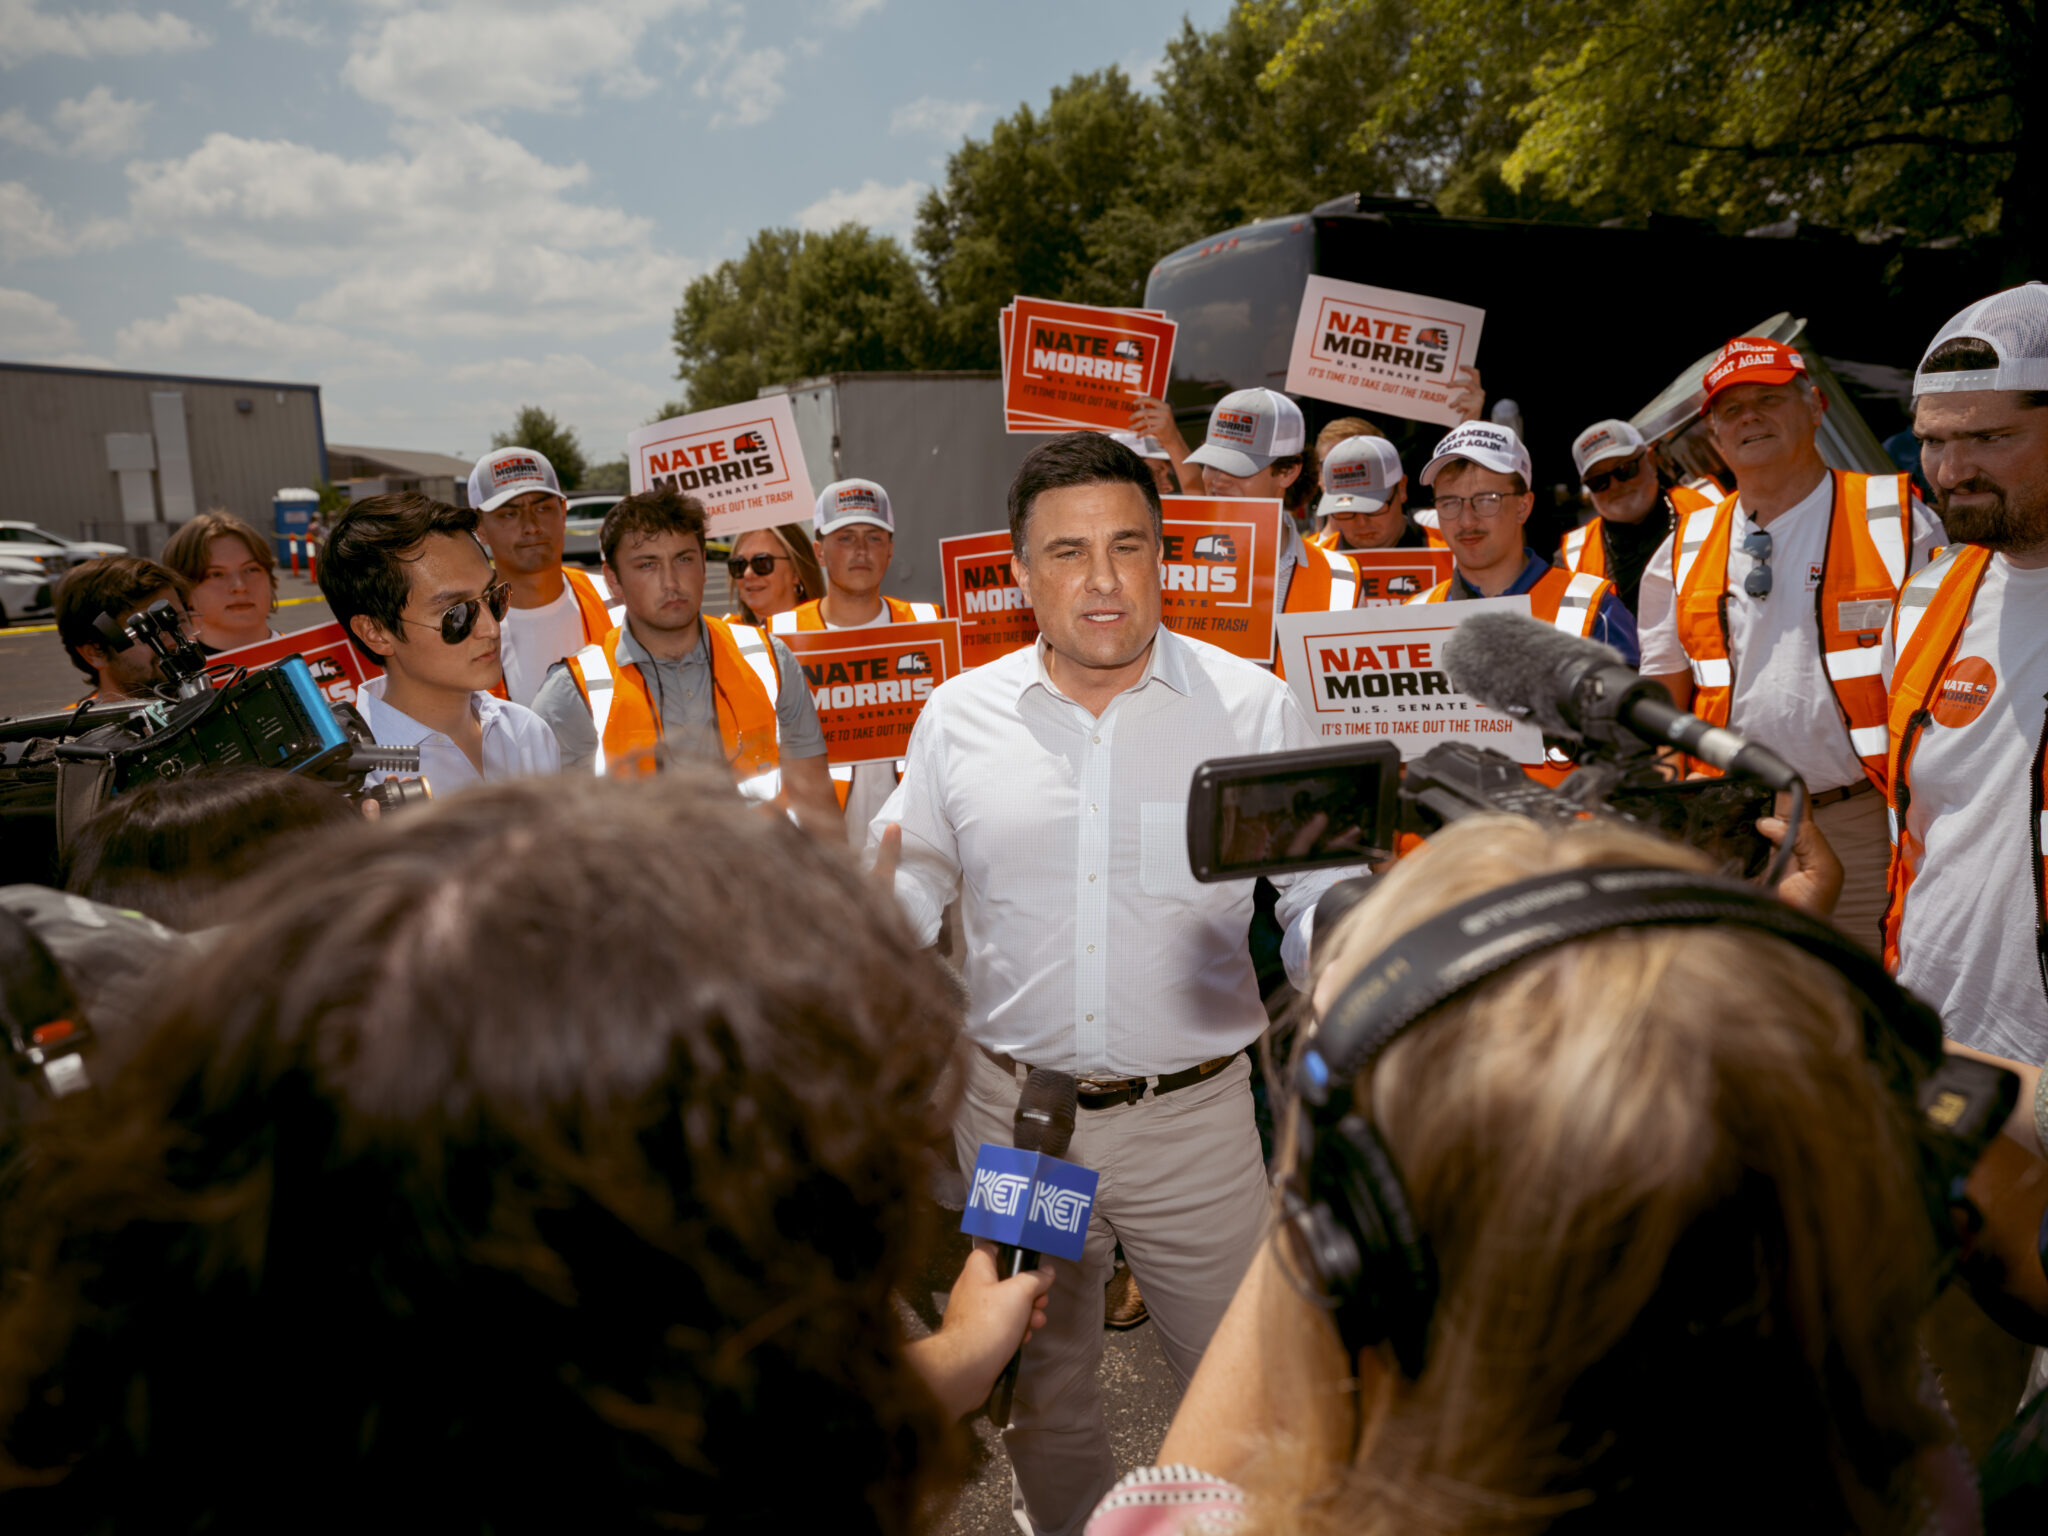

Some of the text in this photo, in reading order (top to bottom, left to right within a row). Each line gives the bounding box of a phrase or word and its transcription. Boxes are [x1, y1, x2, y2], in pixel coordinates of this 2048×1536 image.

[1328, 311, 1412, 345] NATE
[1036, 328, 1109, 357] NATE
[1323, 333, 1446, 374] MORRIS
[1033, 348, 1143, 384] MORRIS
[1336, 359, 1421, 382] U.S. SENATE
[1737, 354, 1774, 369] AGAIN
[1075, 380, 1119, 392] SENATE
[1308, 366, 1449, 404] IT'S TIME TO TAKE OUT THE TRASH
[1459, 428, 1508, 444] AMERICA
[1465, 438, 1502, 451] AGAIN
[648, 440, 728, 475] NATE
[652, 454, 774, 493] MORRIS
[706, 490, 793, 516] TAKE OUT THE TRASH
[708, 483, 758, 499] SENATE
[963, 563, 1012, 589] NAT
[964, 586, 1033, 614] MOR
[1164, 598, 1209, 608] NATE
[1161, 616, 1249, 632] OUT THE TRASH
[802, 657, 888, 686] NATE
[1319, 643, 1433, 673] NATE
[810, 677, 935, 711] MORRIS
[1323, 670, 1462, 700] MORR
[820, 707, 913, 724] U.S. SENATE
[1352, 702, 1467, 714] U.S. SENATE
[838, 729, 850, 741] TO
[852, 726, 875, 740] TAKE
[876, 723, 895, 737] OUT
[1321, 719, 1513, 736] IT'S TIME TO TAKE OUT THE TRASH
[969, 1167, 1030, 1217] KET
[1028, 1180, 1091, 1234] KET
